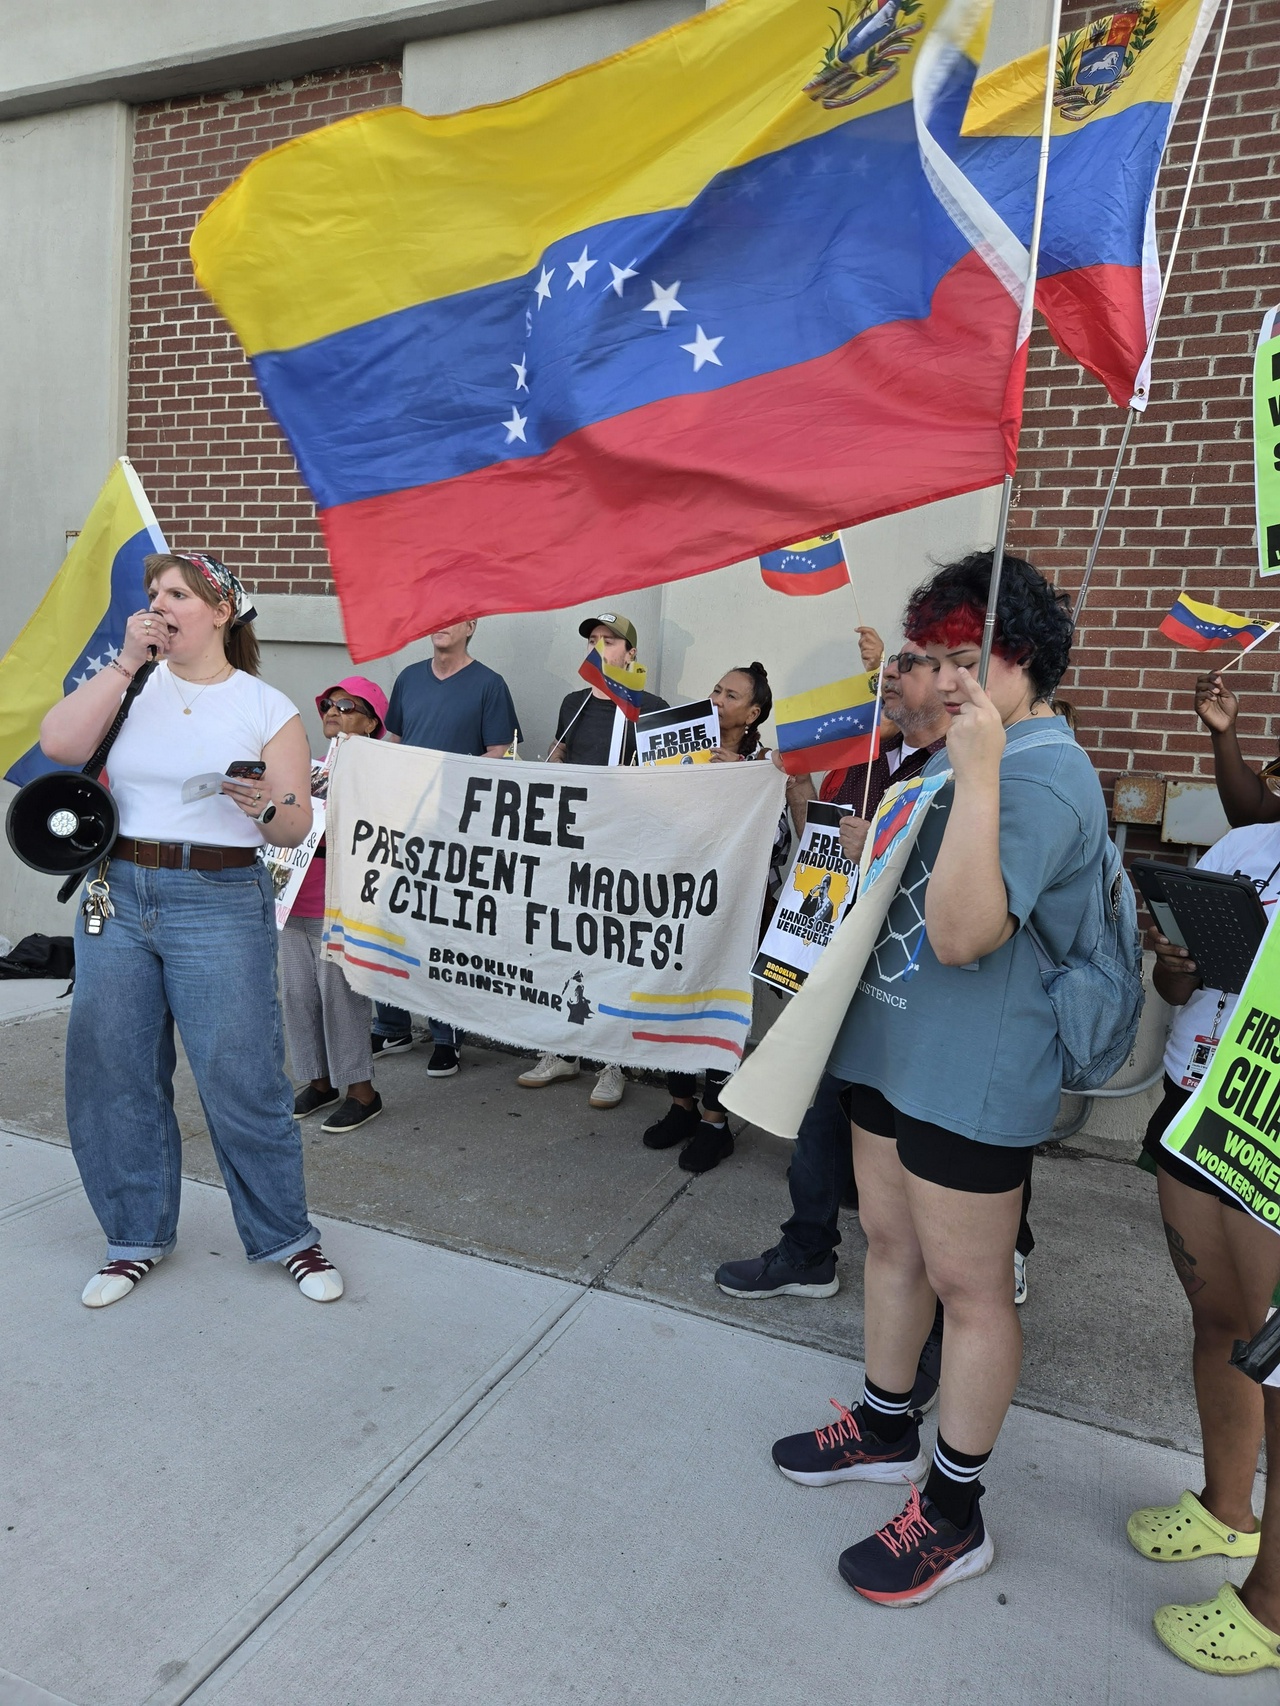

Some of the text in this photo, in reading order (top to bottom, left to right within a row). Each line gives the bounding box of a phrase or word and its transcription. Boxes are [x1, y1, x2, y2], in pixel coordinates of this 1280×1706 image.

[642, 736, 718, 763] MADURO!
[649, 723, 707, 750] FREE
[459, 777, 588, 849] FREE
[809, 832, 845, 858] FRE
[351, 819, 718, 919] PRESIDENT MADURO
[797, 850, 857, 877] MADURO!
[361, 869, 685, 971] & CILIA FLORES!
[779, 908, 835, 937] HANDS OFF
[429, 947, 534, 984] BROOKLYN
[763, 969, 790, 986] AGAINST
[766, 961, 797, 980] BROOKLYN
[428, 966, 563, 1012] AGAINST WAR
[1223, 1129, 1280, 1195] WORKE
[1195, 1144, 1280, 1227] WORKERS WO
